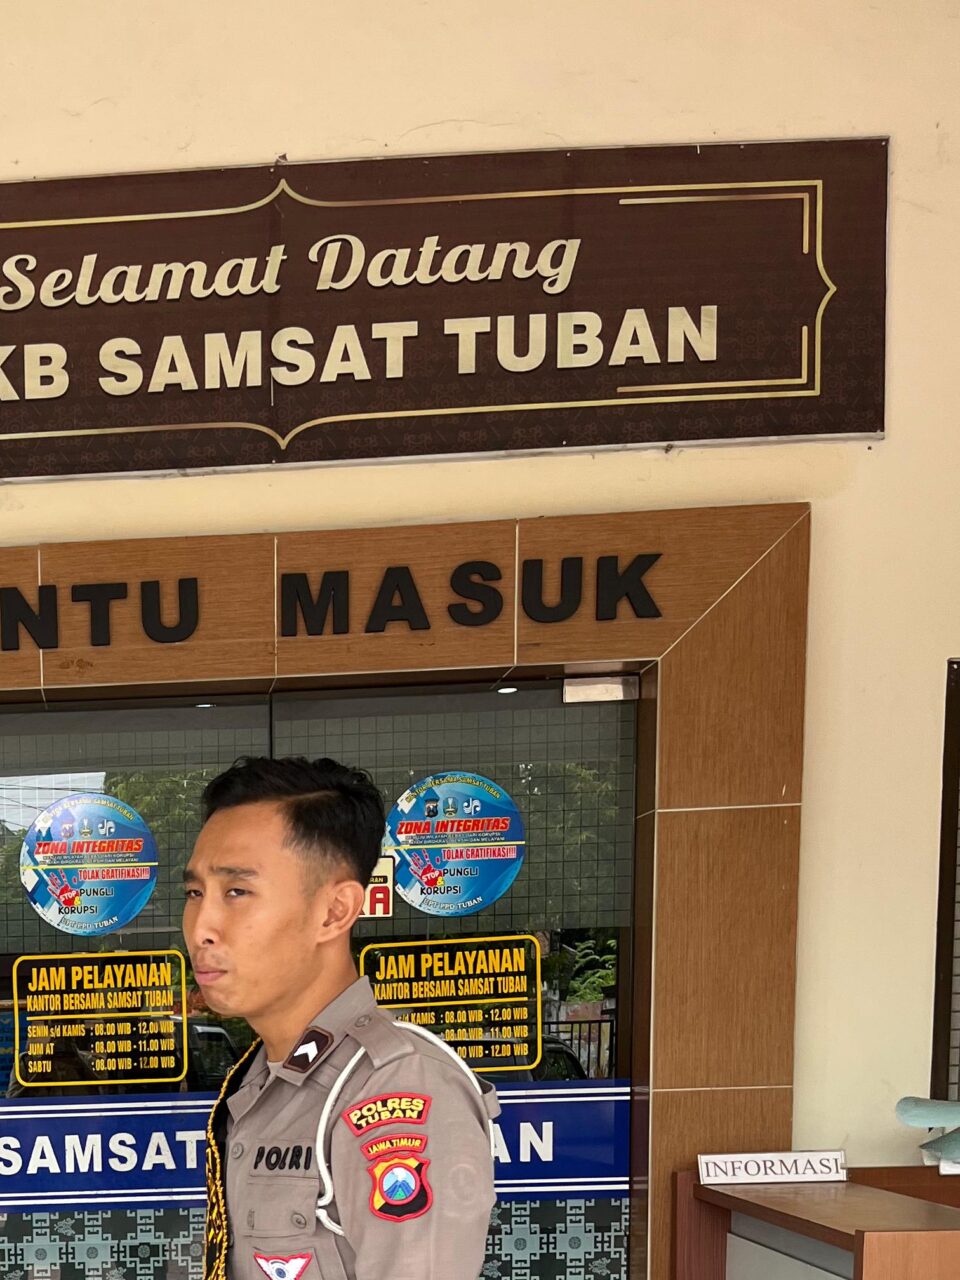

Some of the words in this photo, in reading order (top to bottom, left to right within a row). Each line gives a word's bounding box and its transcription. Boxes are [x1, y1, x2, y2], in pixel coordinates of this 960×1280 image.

[310, 232, 581, 296] Datang
[98, 321, 420, 397] SAMSAT
[444, 304, 719, 374] TUBAN
[280, 553, 665, 638] MASUK
[397, 821, 430, 835] ZONA
[435, 817, 511, 833] INTEGRITAS
[34, 841, 67, 855] ZONA
[71, 838, 144, 853] INTEGRITAS
[442, 848, 464, 860] TOLAK
[78, 868, 100, 881] TOLAK
[421, 871, 440, 882] STOP
[443, 867, 479, 877] PUNGLI
[59, 890, 77, 902] STOP
[79, 888, 114, 897] PUNGLI
[420, 886, 461, 896] KORUPSI
[58, 905, 98, 915] KORUPSI
[375, 954, 415, 981] JAM
[420, 947, 525, 978] PELAYANAN
[28, 966, 66, 992] JAM
[71, 963, 172, 990] PELAYANAN
[374, 982, 410, 1000] KANTOR
[412, 979, 456, 999] BERSAMA
[457, 977, 494, 996] SAMSAT
[497, 975, 528, 994] TUBAN
[26, 994, 61, 1012] KANTOR
[63, 992, 105, 1010] BERSAMA
[107, 990, 142, 1009] SAMSAT
[144, 989, 173, 1007] TUBAN
[410, 1012, 436, 1025] KAMIS
[468, 1010, 483, 1022] WIB
[490, 1009, 511, 1021] 12.00
[513, 1007, 529, 1020] WIB
[27, 1025, 49, 1038] SENIN
[49, 1024, 61, 1038] s/d
[62, 1024, 86, 1036] KAMIS
[117, 1022, 132, 1034] WIB
[160, 1021, 175, 1033] WIB
[468, 1028, 483, 1040] WIB
[490, 1027, 511, 1039] 11.00
[513, 1025, 529, 1038] WIB
[117, 1040, 132, 1052] WIB
[160, 1039, 175, 1050] WIB
[469, 1045, 484, 1058] WIB
[490, 1044, 511, 1057] 12.00
[513, 1043, 529, 1056] WIB
[27, 1061, 52, 1073] SABTU
[118, 1058, 132, 1070] WIB
[161, 1056, 175, 1068] WIB
[352, 1097, 425, 1124] POLRES
[356, 1109, 419, 1129] TUBAN
[368, 1140, 392, 1155] JAWA
[391, 1138, 422, 1149] TIMUR
[253, 1144, 313, 1171] POLRI
[704, 1157, 841, 1178] INFORMASI
